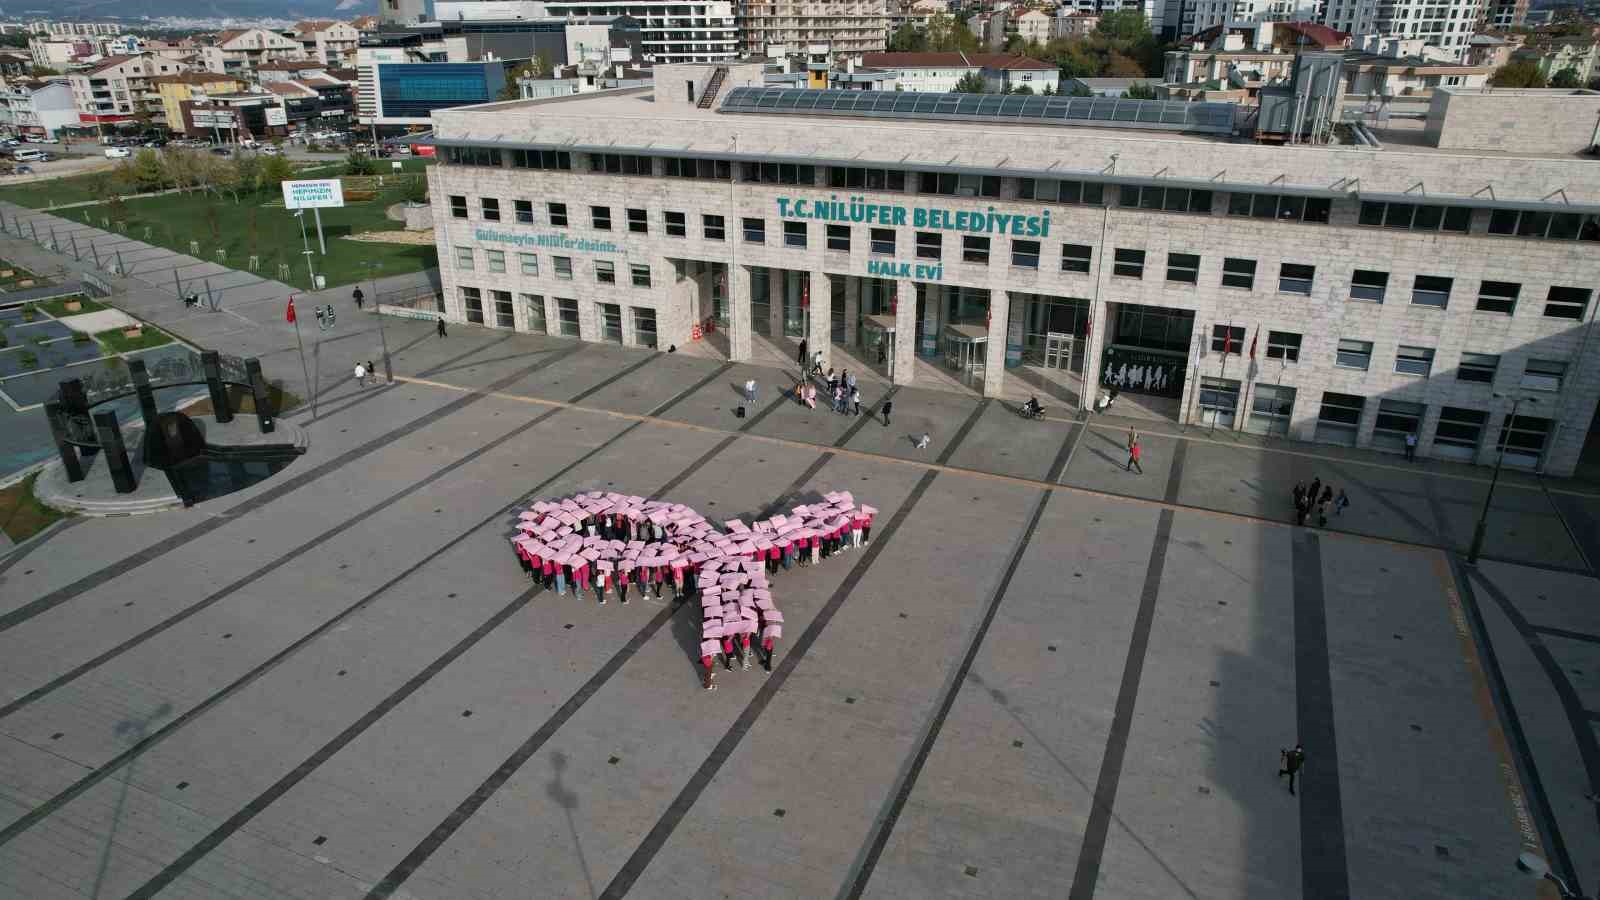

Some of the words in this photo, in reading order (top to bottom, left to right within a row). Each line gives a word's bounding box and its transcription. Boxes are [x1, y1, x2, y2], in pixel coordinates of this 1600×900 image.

[913, 206, 1049, 237] BELEDİYESİ
[867, 260, 911, 277] HALK
[915, 262, 943, 280] EVİ
